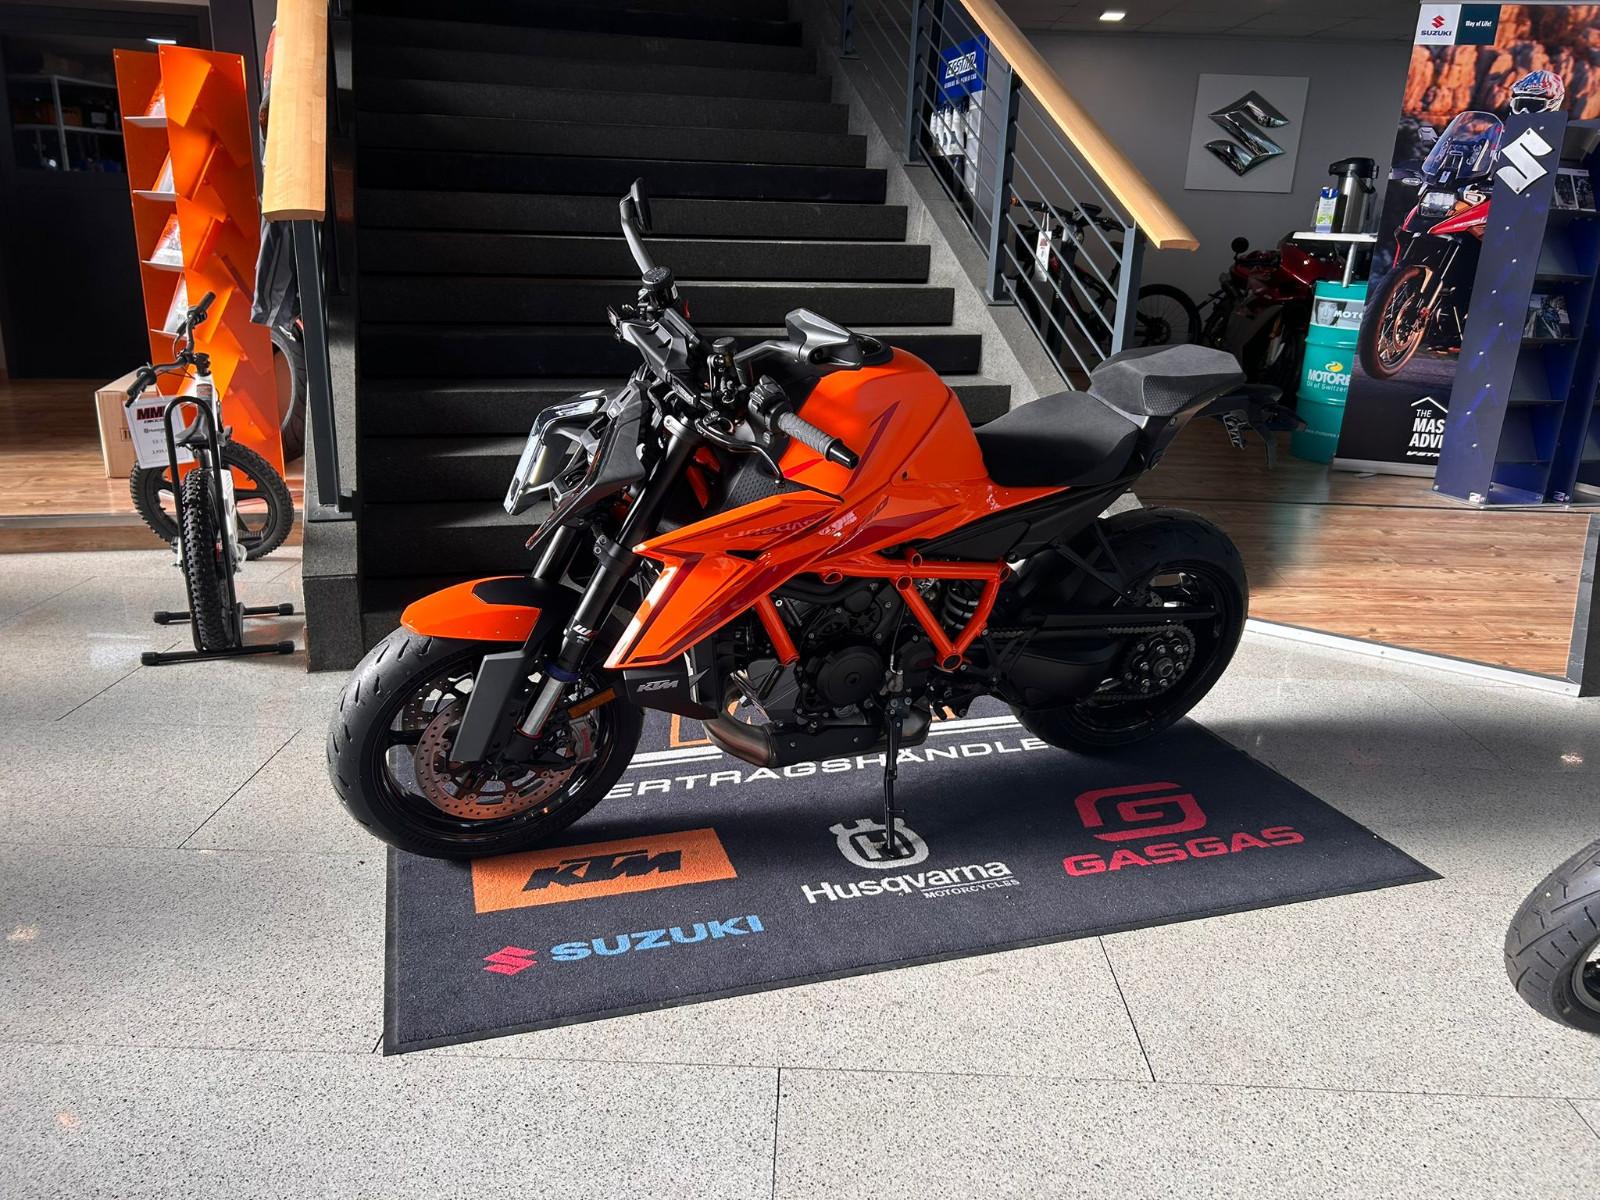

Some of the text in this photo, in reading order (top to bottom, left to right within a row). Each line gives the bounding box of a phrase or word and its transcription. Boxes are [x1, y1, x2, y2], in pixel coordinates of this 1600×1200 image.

[1416, 409, 1432, 417] THE
[637, 679, 679, 692] KTM
[521, 849, 682, 892] KTM
[1062, 826, 1305, 877] GASGAS
[800, 861, 1013, 904] Husqvarna
[923, 879, 1020, 899] MOTORCYCLES
[550, 914, 765, 962] SUZUKI
